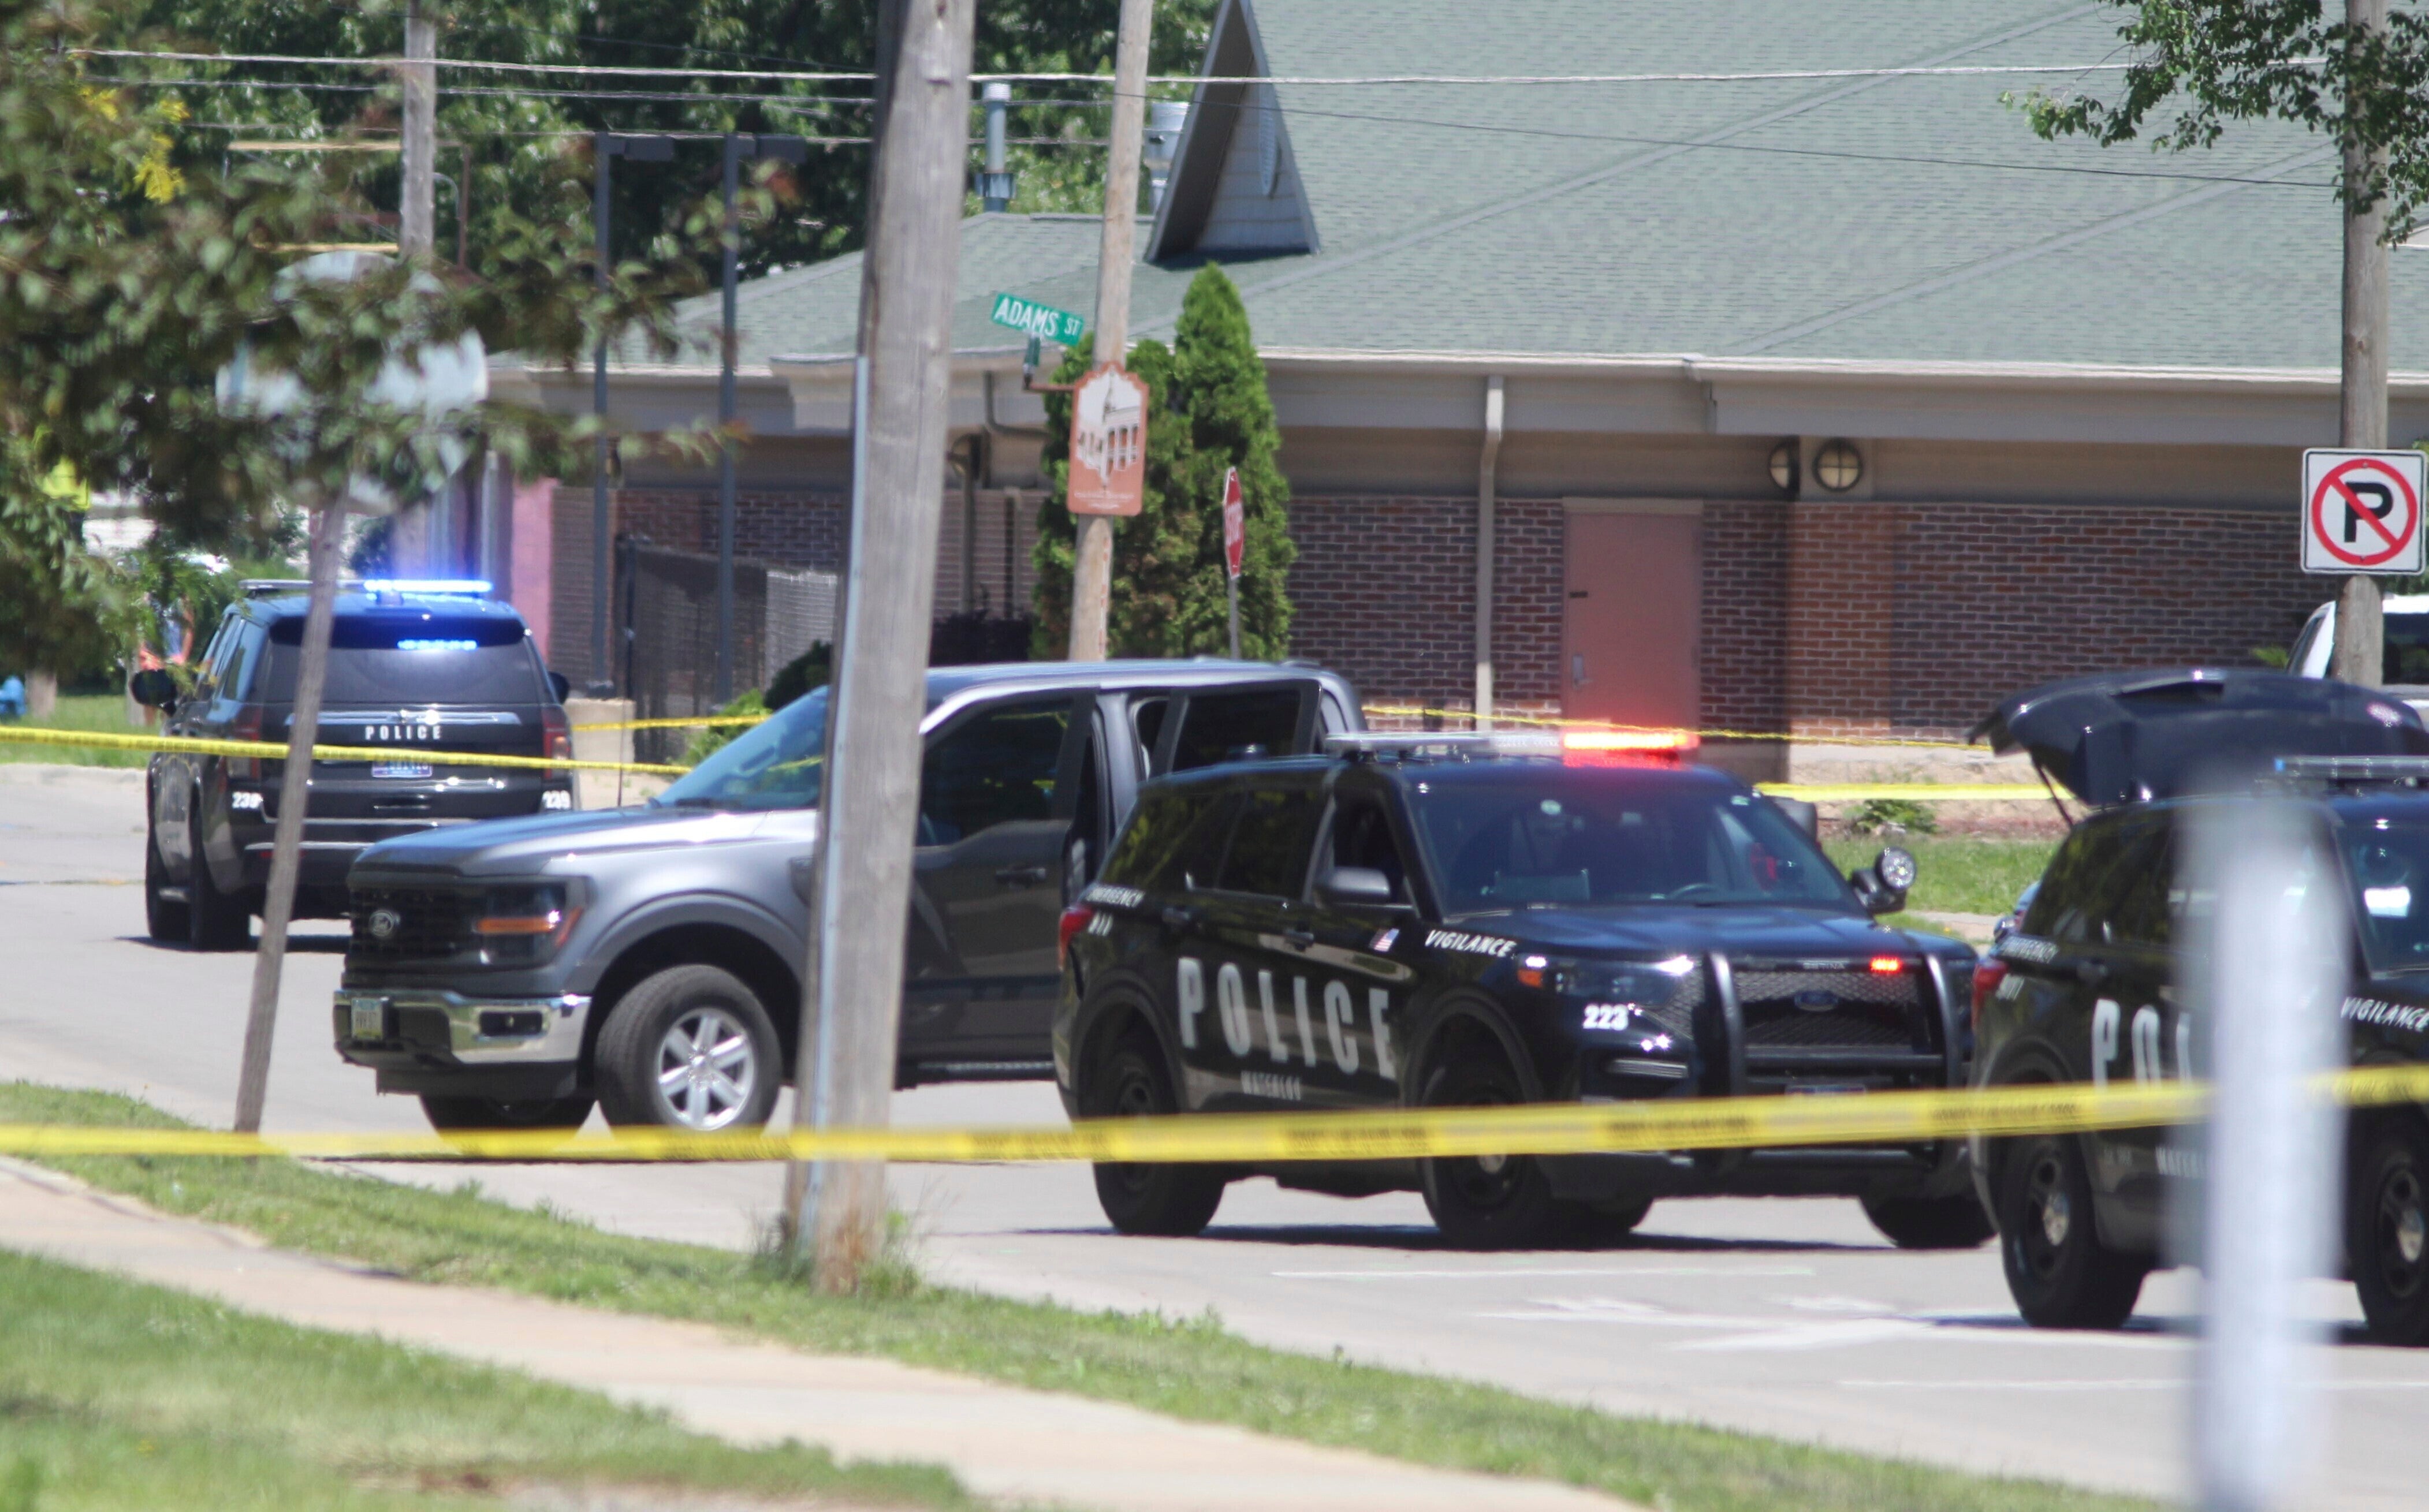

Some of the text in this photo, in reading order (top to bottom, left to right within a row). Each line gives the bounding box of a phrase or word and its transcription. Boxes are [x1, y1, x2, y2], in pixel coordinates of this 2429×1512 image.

[993, 297, 1081, 336] ADAMS ST
[2344, 482, 2394, 543] P
[364, 725, 442, 741] POLICE
[1425, 929, 1517, 958] VIGILANCE
[1178, 956, 1398, 1080] POLICE
[1583, 1003, 1628, 1031] 223
